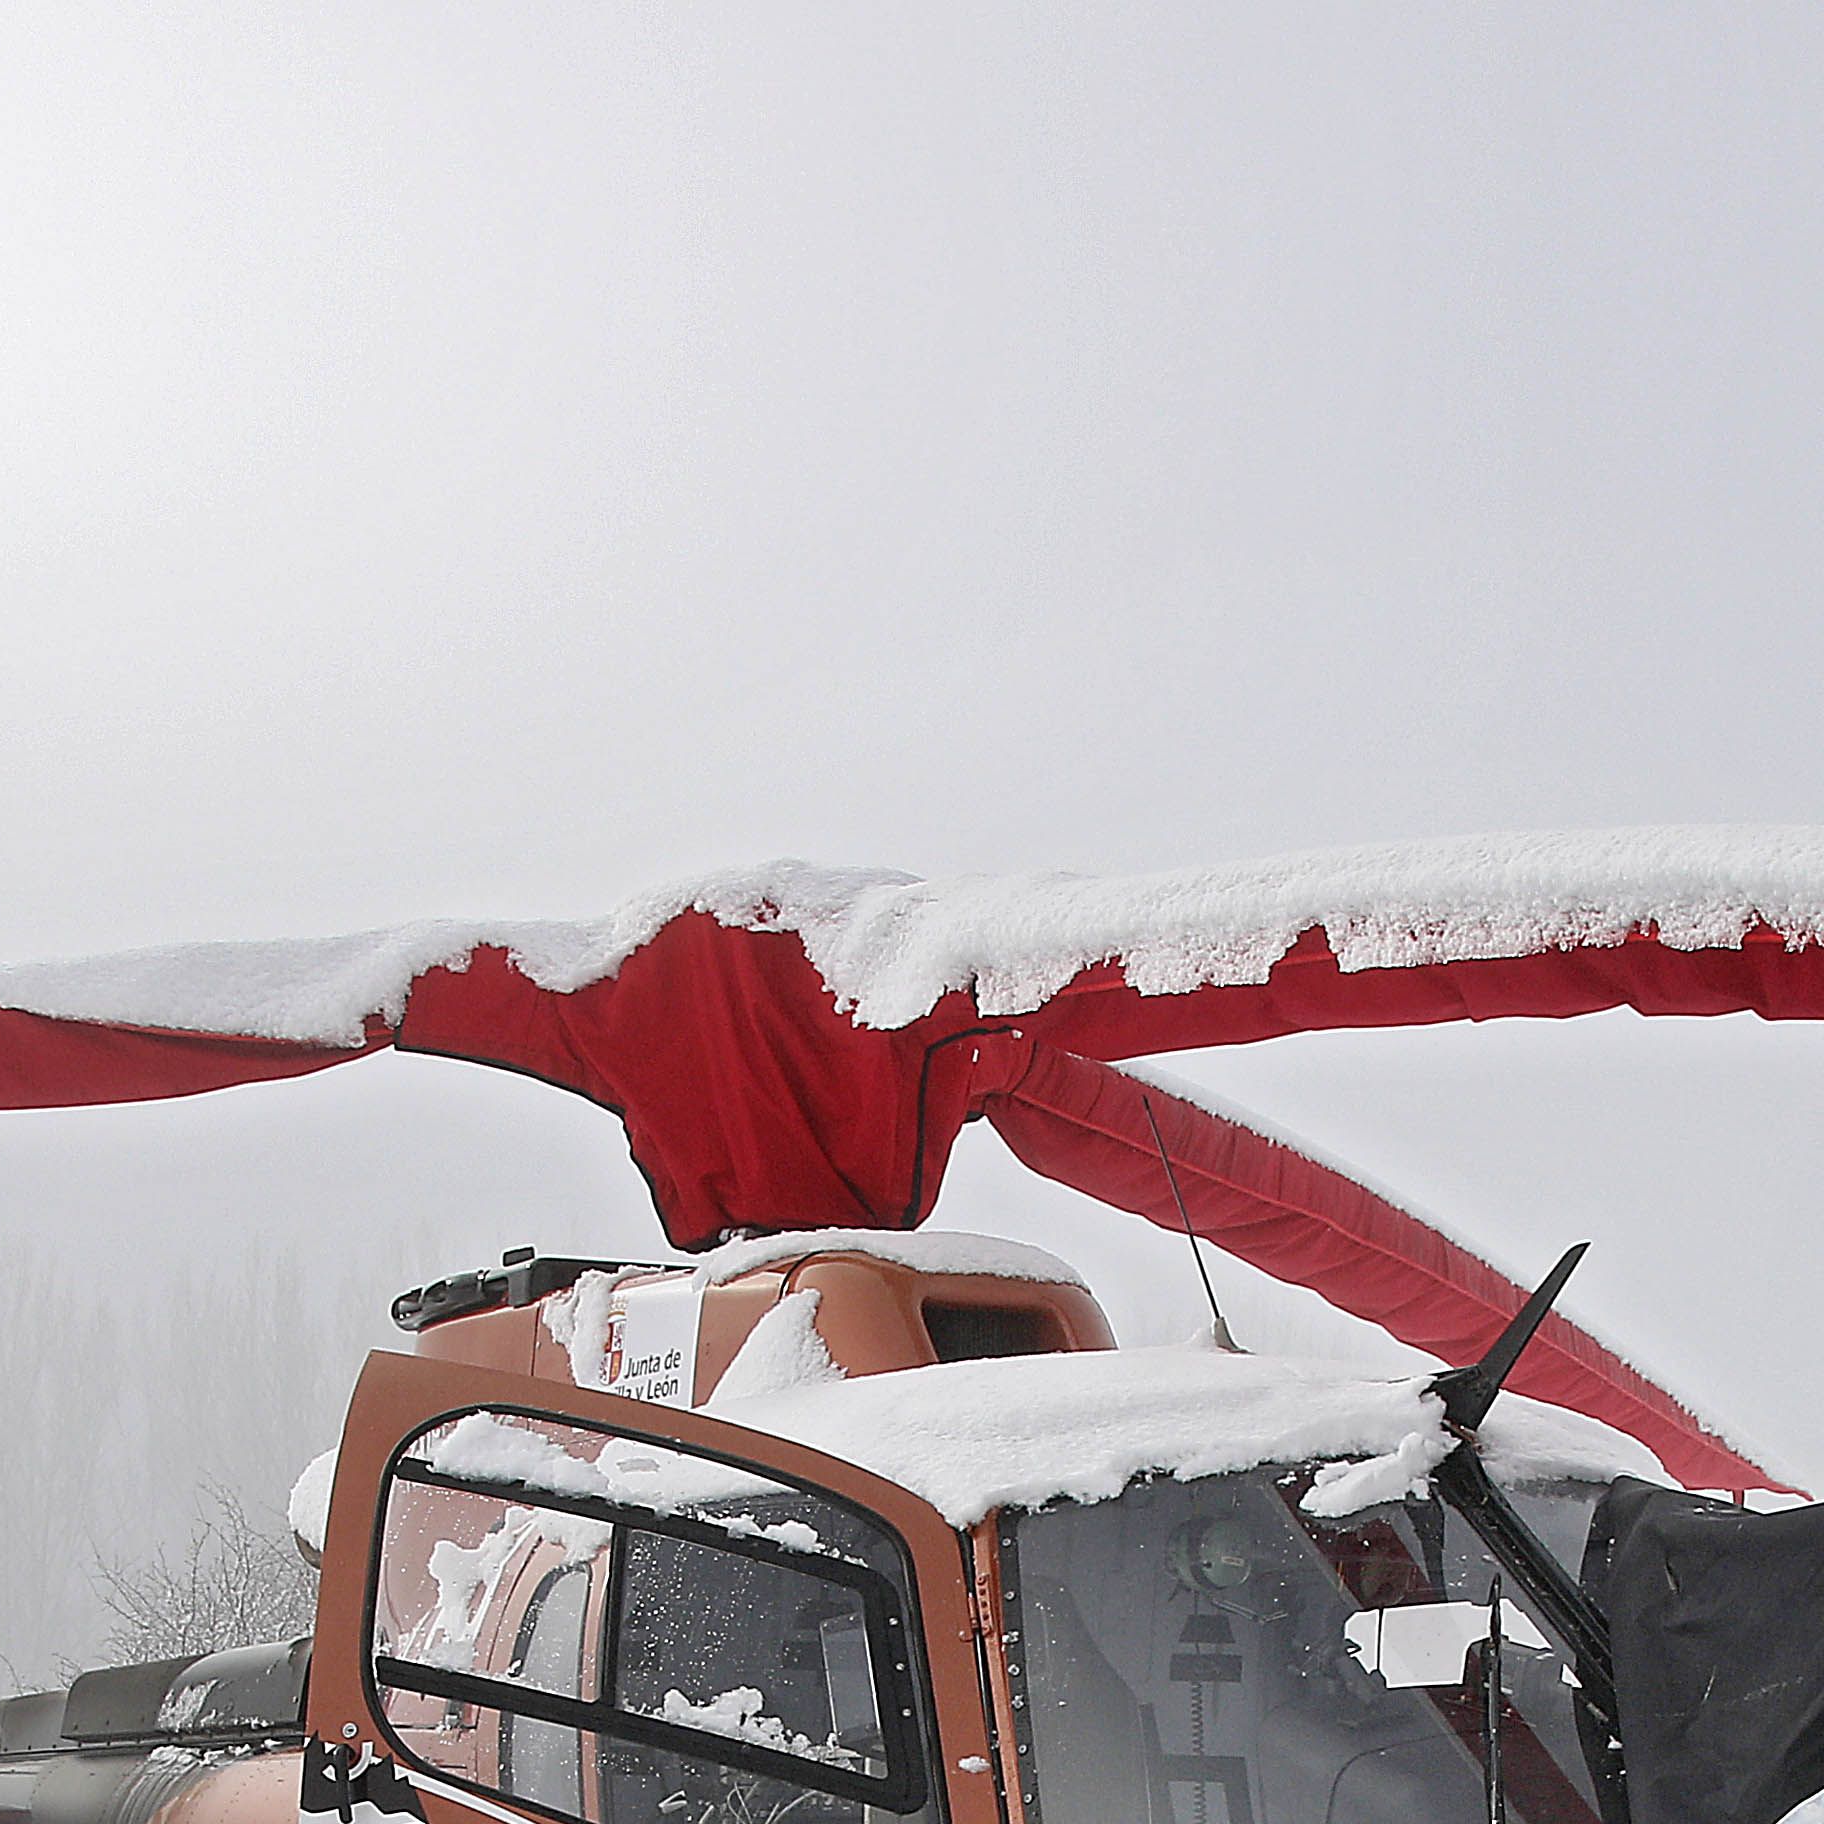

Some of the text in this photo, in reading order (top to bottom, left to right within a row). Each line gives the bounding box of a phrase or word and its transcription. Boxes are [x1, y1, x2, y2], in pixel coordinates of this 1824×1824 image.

[624, 1348, 682, 1379] Junta de
[646, 1374, 679, 1400] León
